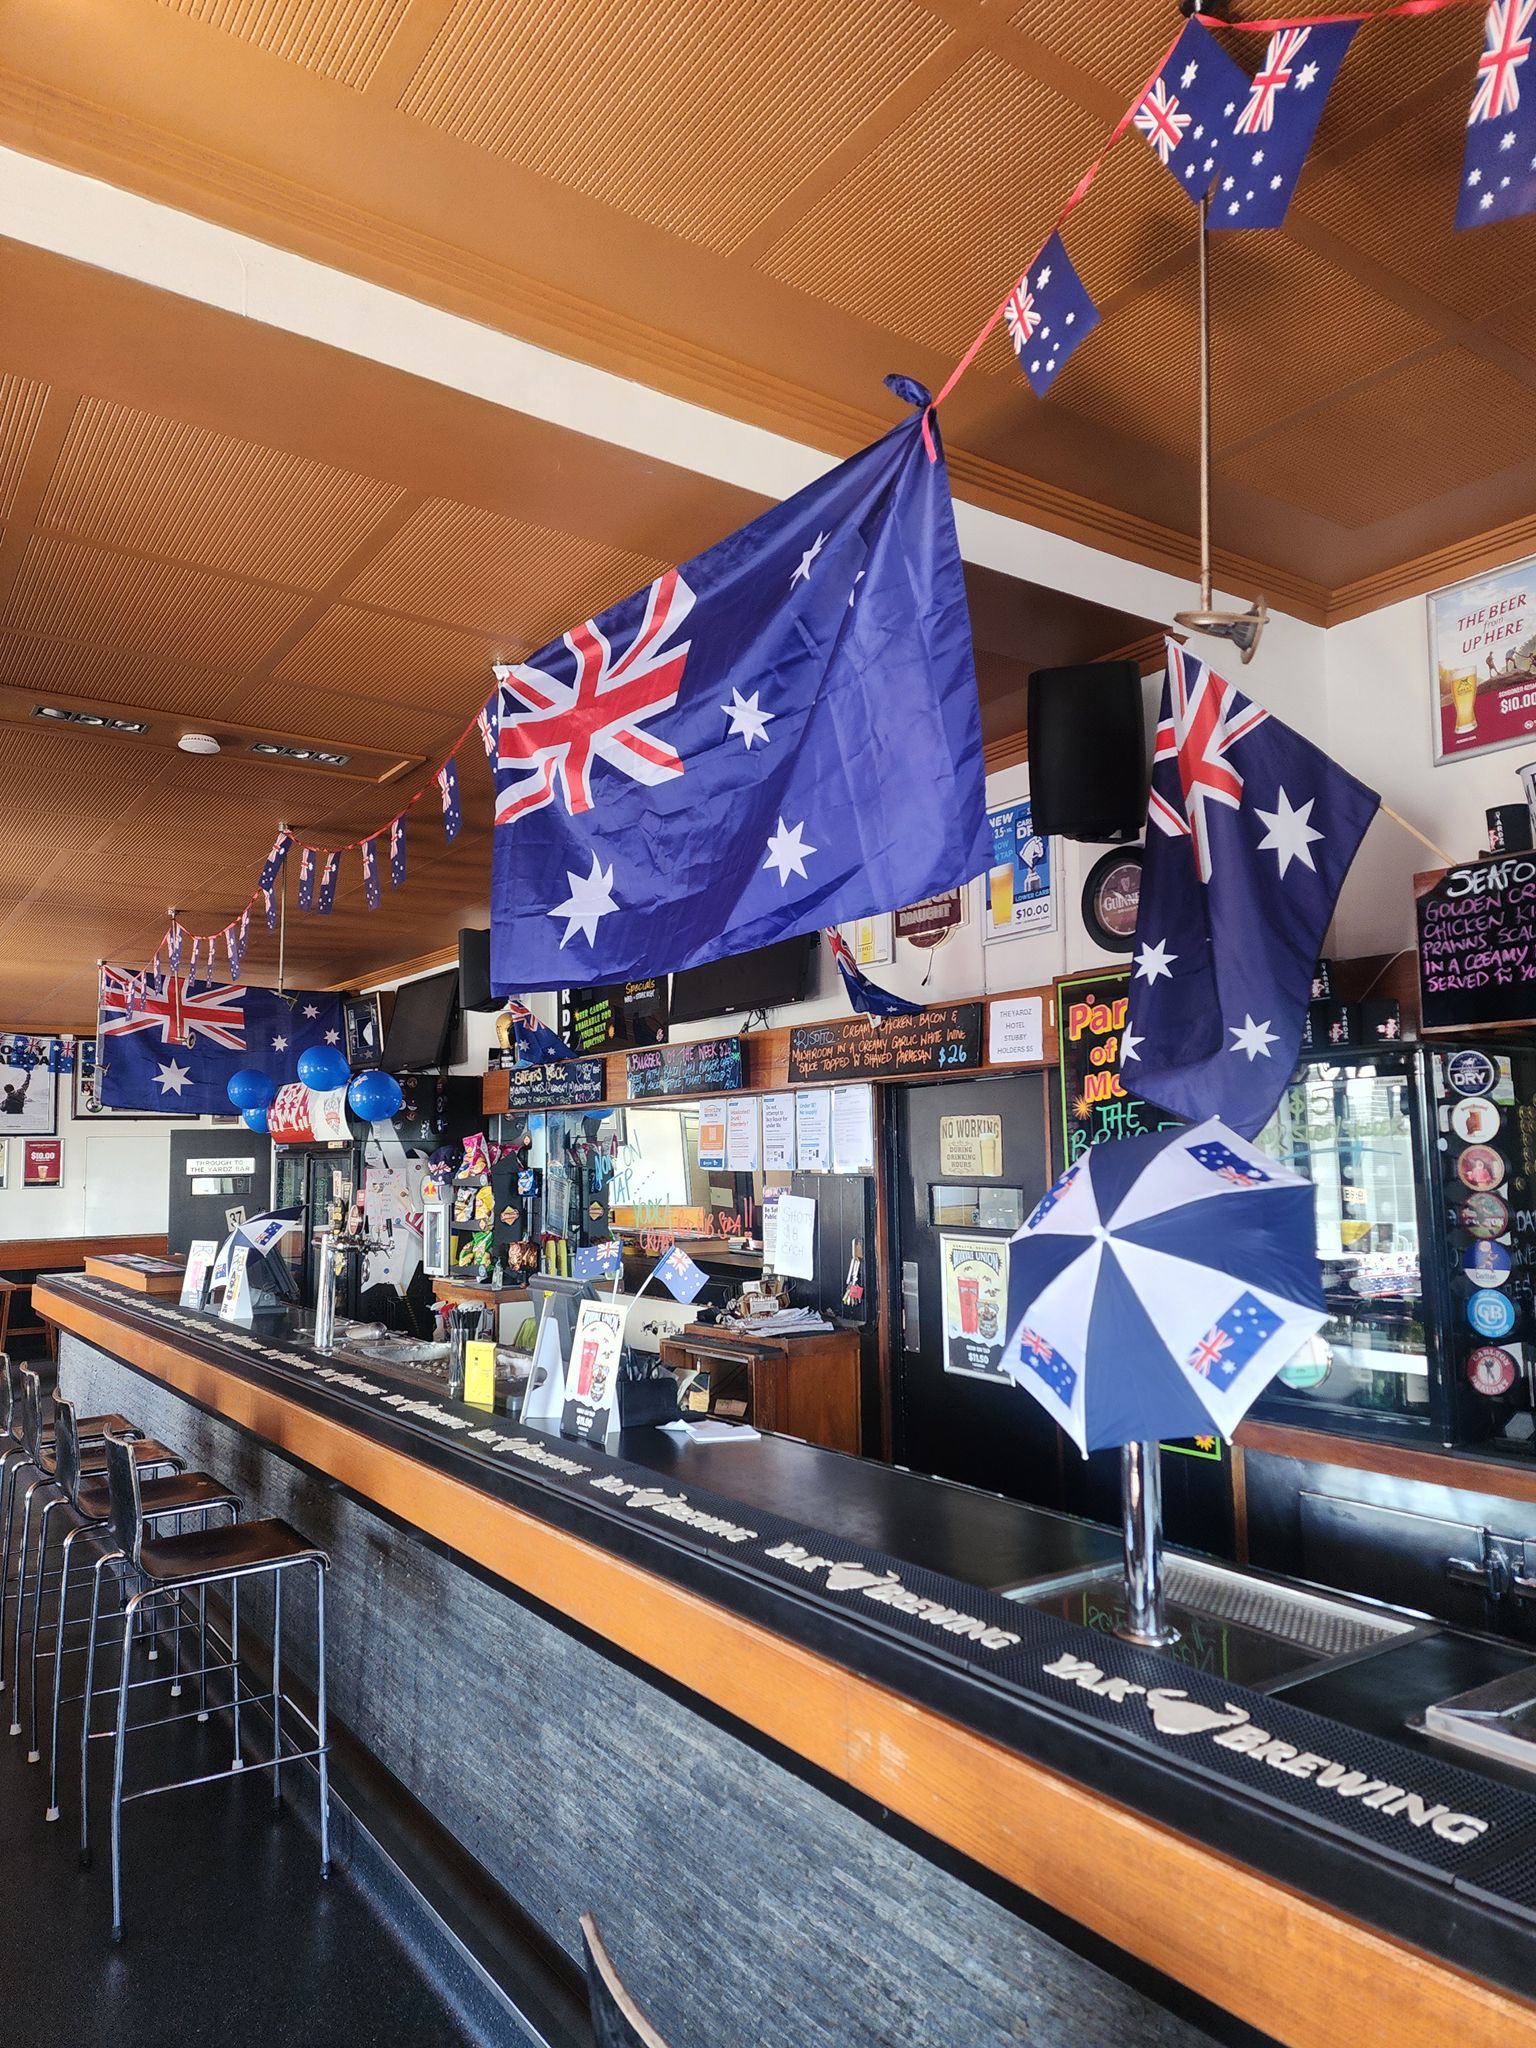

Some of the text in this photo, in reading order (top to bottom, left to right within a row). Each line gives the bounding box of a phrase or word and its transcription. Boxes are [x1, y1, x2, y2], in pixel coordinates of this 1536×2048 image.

[1458, 594, 1527, 632] THE BEER
[1483, 616, 1504, 633] from
[1462, 619, 1524, 653] UP HERE
[1446, 860, 1536, 897] SEAFO
[1015, 893, 1034, 902] LOWER
[1103, 891, 1140, 911] GUINNE
[1425, 883, 1536, 921] GOLDEN CR
[900, 903, 952, 927] DRAUGHT
[1016, 904, 1049, 919] $10.00
[1423, 904, 1536, 940] CHICKEN KI
[1498, 925, 1536, 944] SCAL
[1424, 960, 1444, 975] IN
[1448, 958, 1460, 974] A
[625, 979, 655, 995] Specials
[1427, 971, 1489, 992] SERVED
[919, 1012, 947, 1028] BACON
[951, 1010, 958, 1023] &
[1068, 997, 1130, 1042] Par
[791, 1027, 967, 1064] MUSHROOM IN A CREAMY GARLIC WHITE WINE
[1089, 1036, 1118, 1066] of
[631, 1052, 661, 1072] BURGER
[799, 1060, 819, 1078] SAUCE
[821, 1056, 849, 1073] TOPPED
[863, 1050, 893, 1067] SHAVED
[895, 1047, 932, 1069] PARMESAN
[938, 1044, 968, 1069] $26
[1453, 1072, 1485, 1086] DRY
[942, 1119, 999, 1139] NO WORKING
[1095, 1101, 1145, 1140] THE
[606, 1168, 633, 1204] TAP
[975, 1252, 999, 1273] UNION
[1472, 1349, 1511, 1366] CARLTON
[765, 1541, 1022, 1651] YAK BREWING
[1043, 1653, 1489, 1846] YAK BREWING
